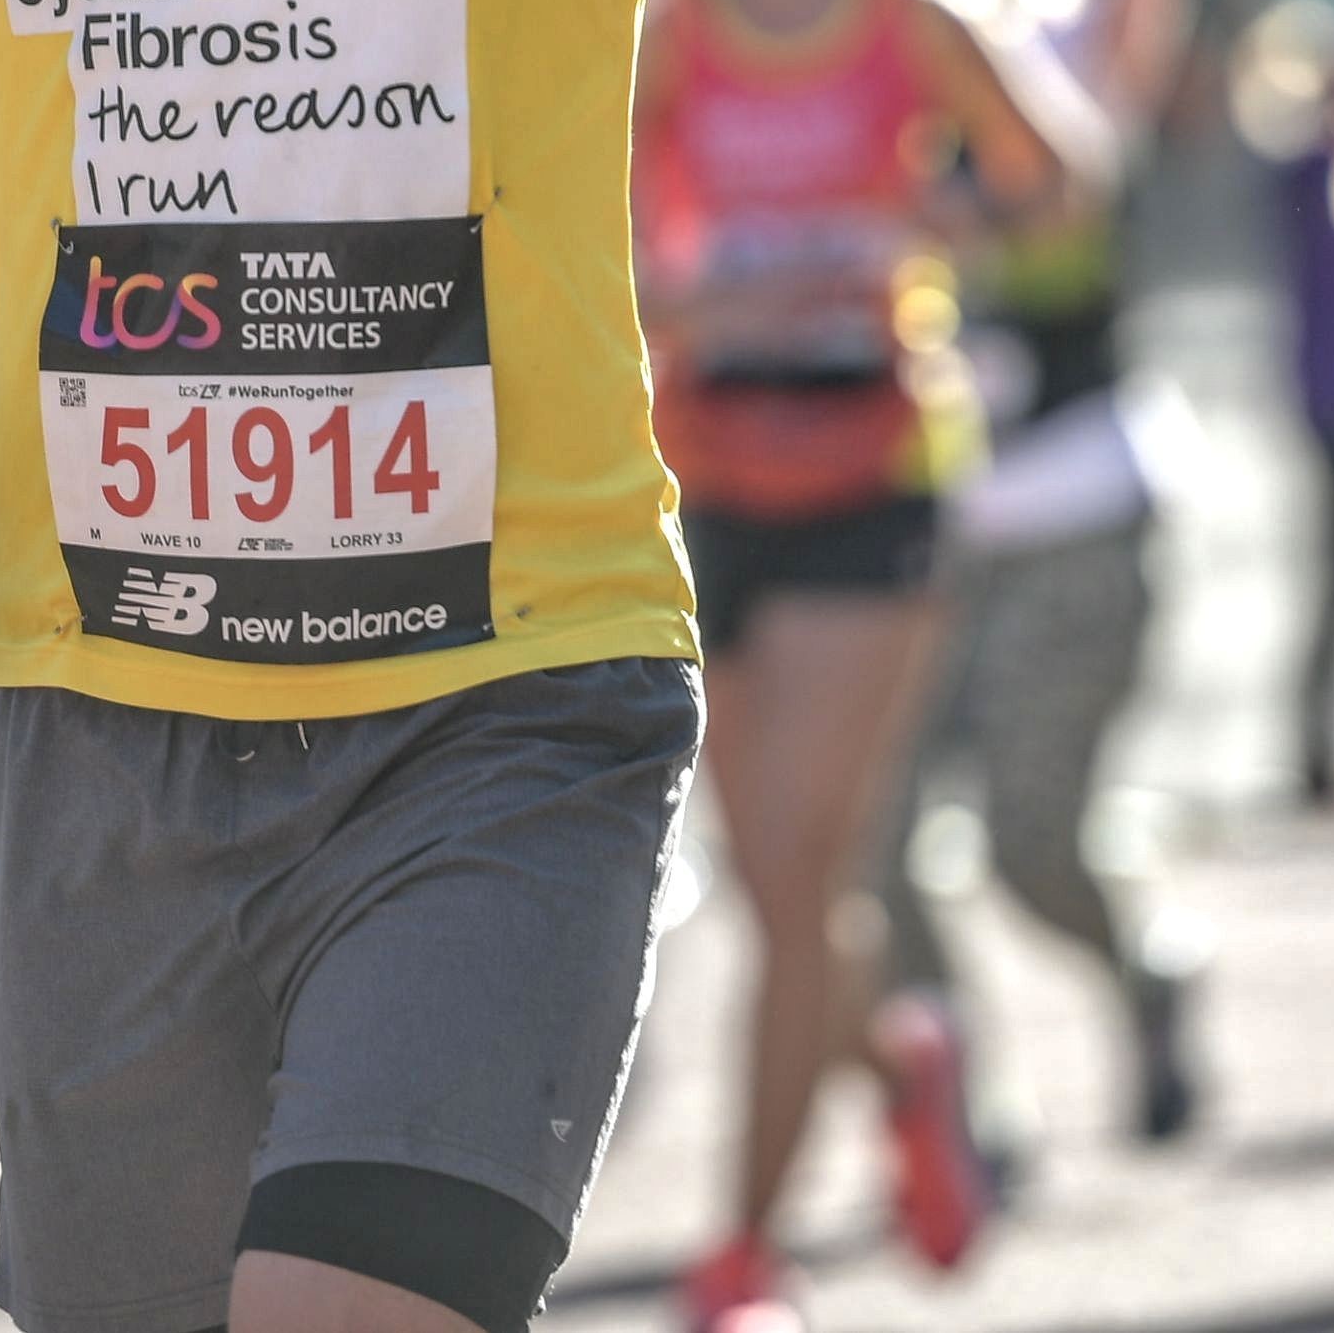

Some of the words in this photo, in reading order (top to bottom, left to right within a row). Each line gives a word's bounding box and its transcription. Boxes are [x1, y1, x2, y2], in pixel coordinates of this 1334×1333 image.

[82, 0, 338, 70] Fibrosis
[88, 86, 198, 143] the
[216, 82, 455, 138] reason
[86, 160, 101, 214] I
[118, 165, 238, 217] run
[240, 252, 336, 280] TATA
[79, 254, 223, 351] tcs
[240, 281, 454, 316] CONSULTANCY
[240, 321, 382, 352] SERVICES
[228, 384, 354, 401] #WeRunTogether
[100, 400, 440, 523] 51914
[89, 528, 102, 540] M
[140, 532, 181, 548] WAVE
[187, 535, 201, 549] 10
[330, 533, 383, 549] LORRY
[386, 531, 404, 546] 33
[222, 614, 294, 644] new
[302, 601, 448, 643] balance
